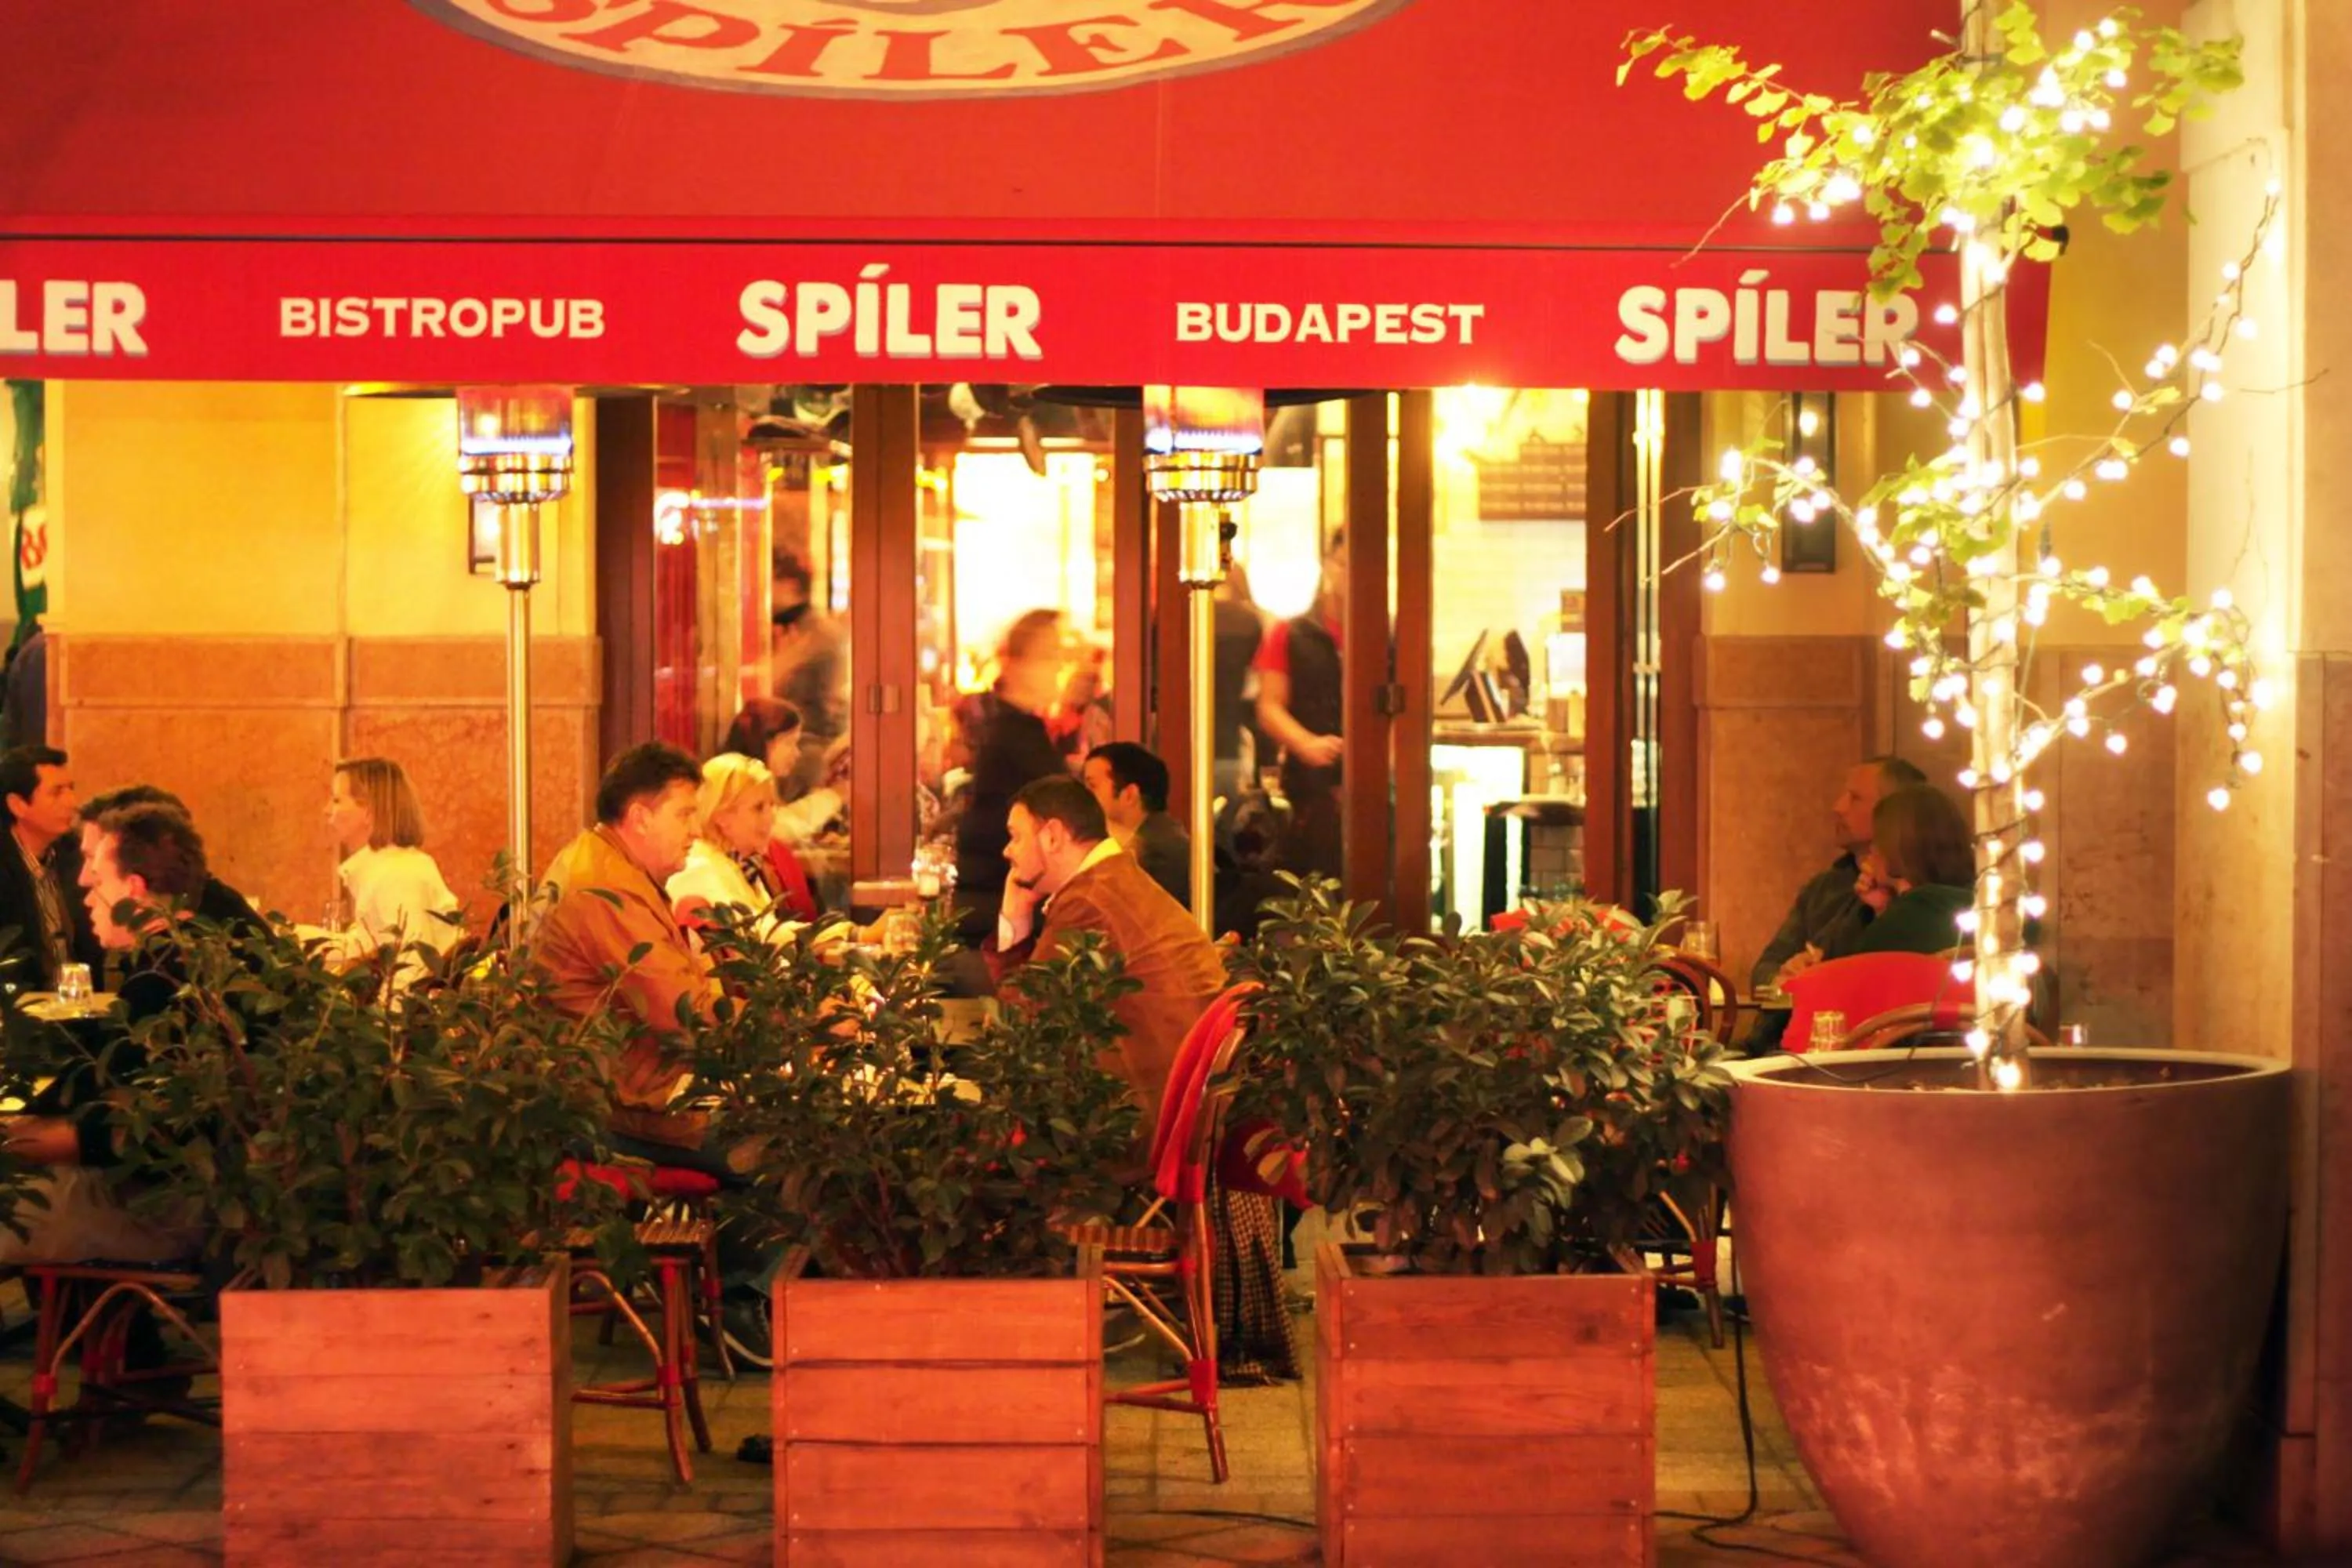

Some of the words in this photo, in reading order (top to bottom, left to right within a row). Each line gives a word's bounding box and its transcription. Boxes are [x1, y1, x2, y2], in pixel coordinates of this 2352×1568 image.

[279, 296, 605, 339] BISTROPUB
[735, 263, 1043, 361] SPÍLER
[1176, 301, 1485, 345] BUDAPEST
[1613, 269, 1921, 366] SPÍLER
